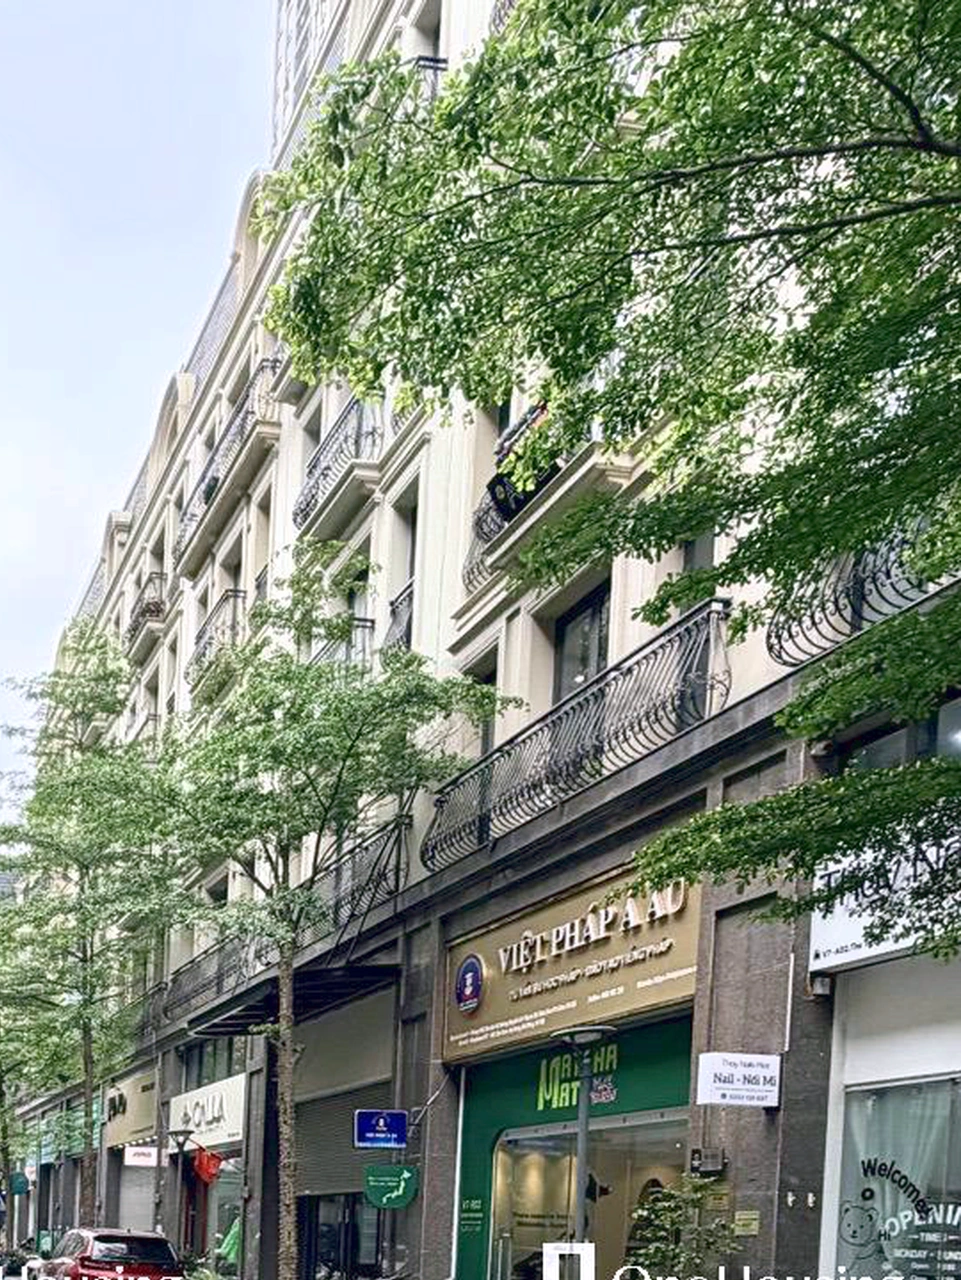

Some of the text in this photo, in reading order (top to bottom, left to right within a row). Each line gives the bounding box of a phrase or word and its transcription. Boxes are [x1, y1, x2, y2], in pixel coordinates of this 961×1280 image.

[498, 930, 549, 974] VIỆT
[551, 901, 618, 957] PHÁP
[861, 1158, 932, 1216] Welcome
